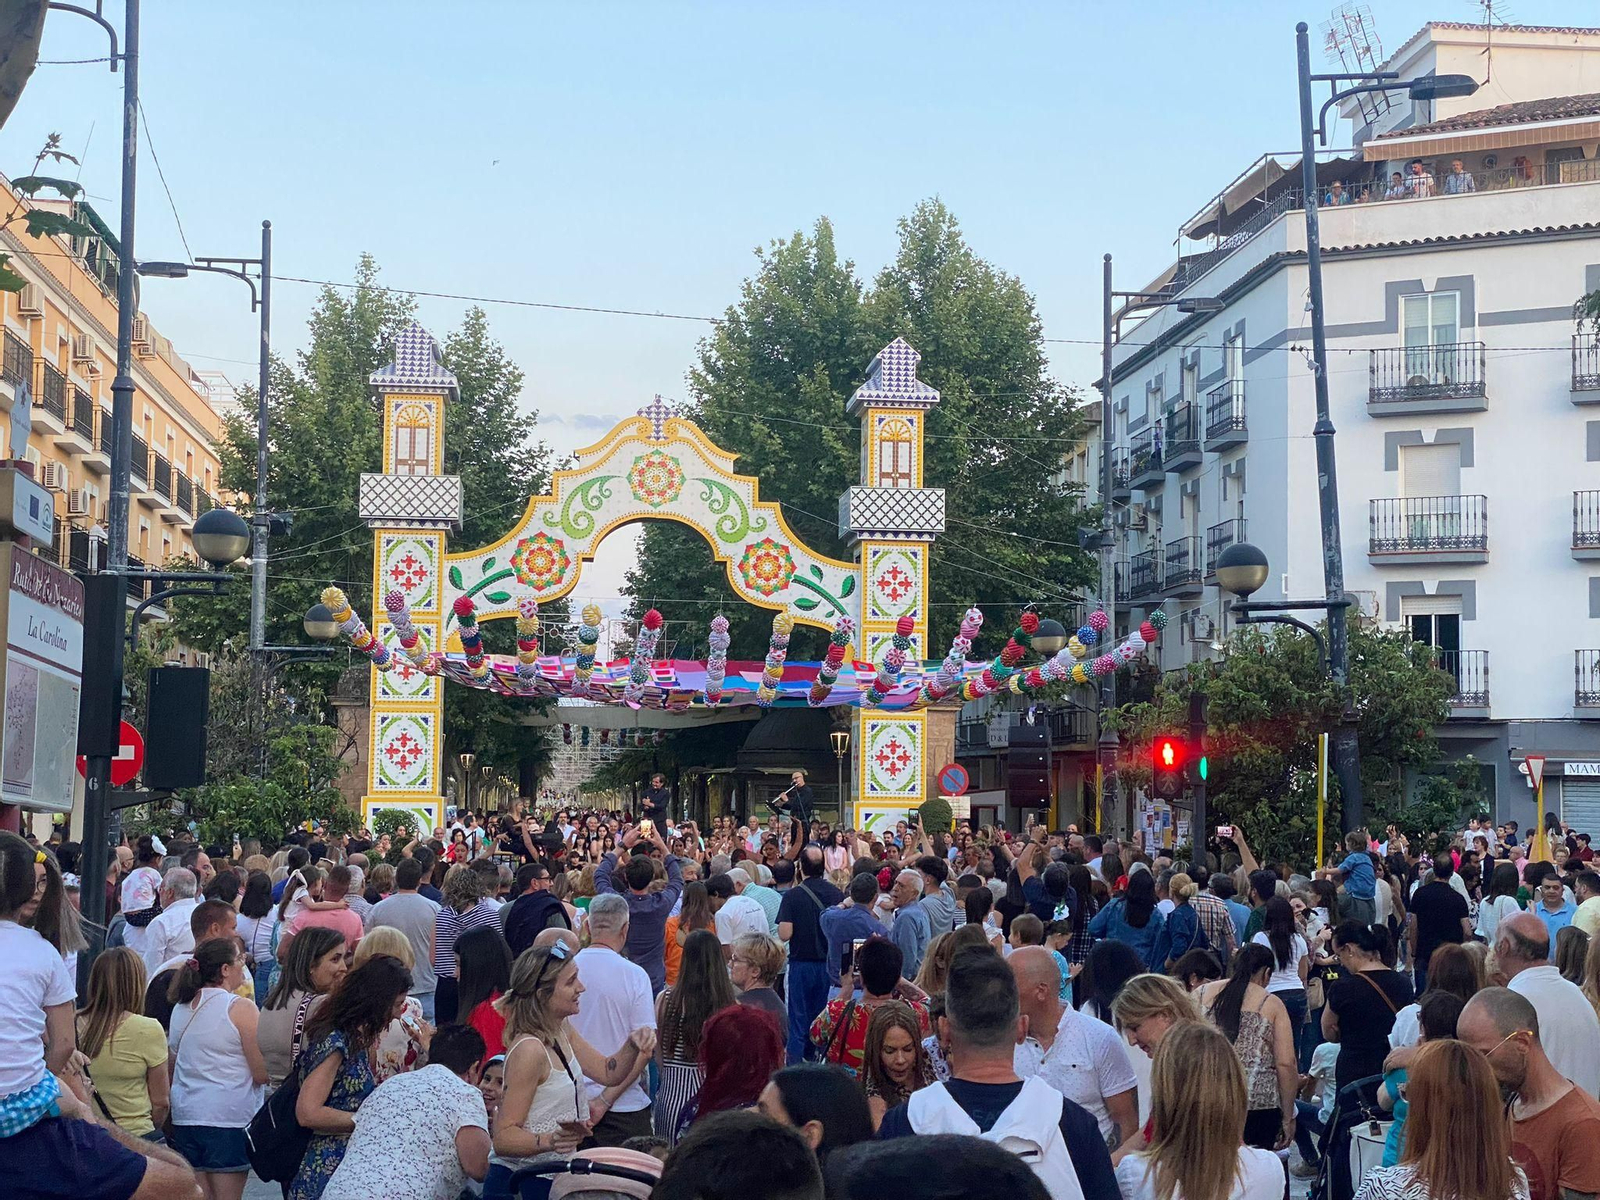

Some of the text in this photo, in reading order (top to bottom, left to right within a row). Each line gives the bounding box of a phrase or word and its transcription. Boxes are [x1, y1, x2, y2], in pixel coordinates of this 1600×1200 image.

[13, 561, 31, 592] Ruta
[27, 615, 68, 652] La Carolina
